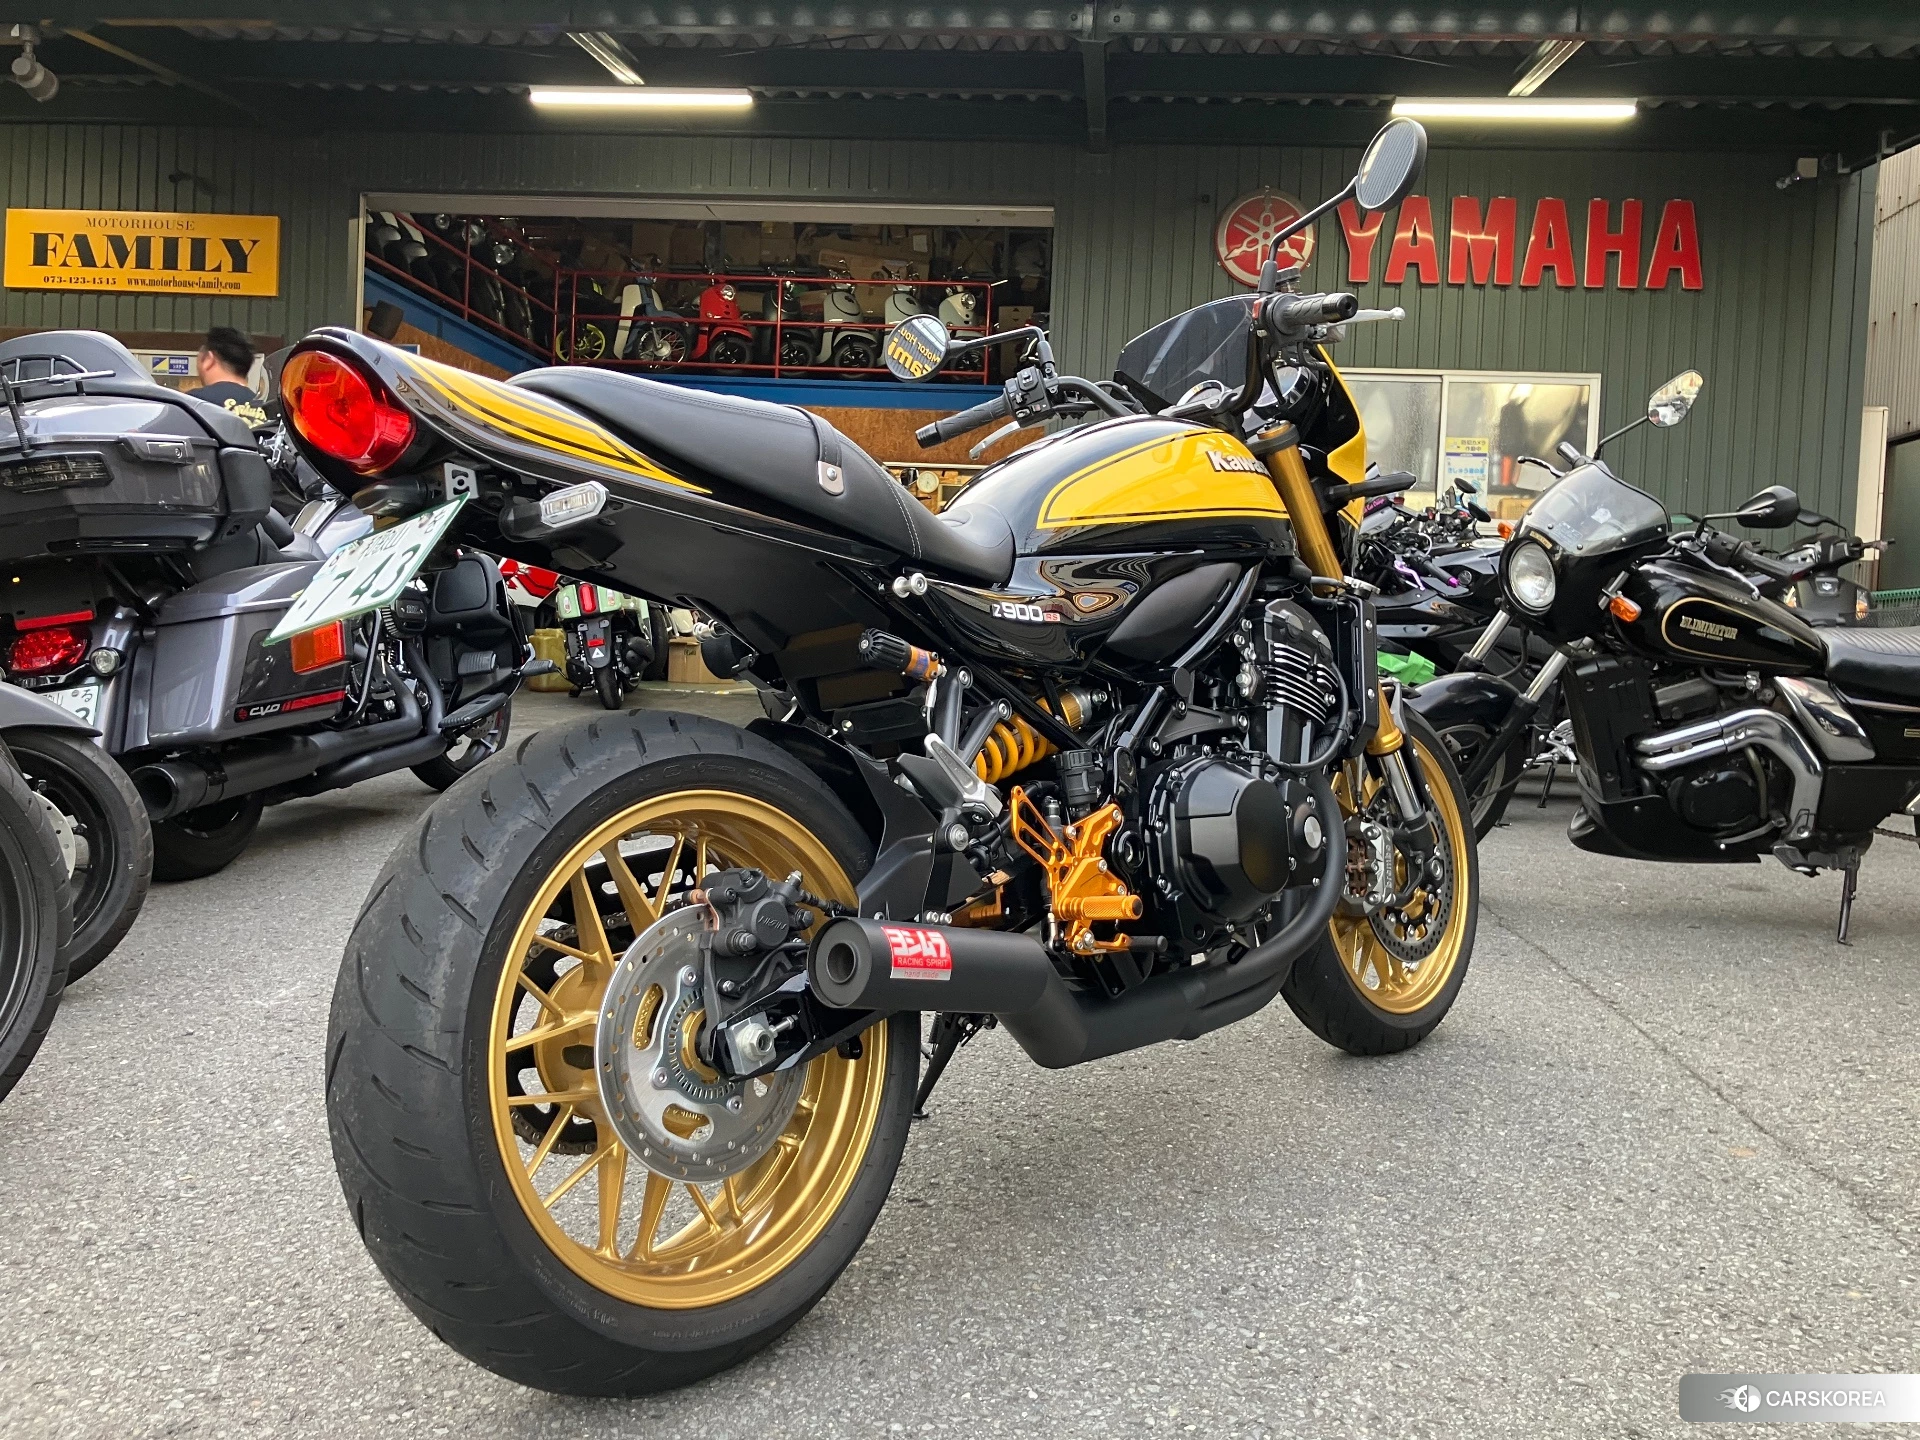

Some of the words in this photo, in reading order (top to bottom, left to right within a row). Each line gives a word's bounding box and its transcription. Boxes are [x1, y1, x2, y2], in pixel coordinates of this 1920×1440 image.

[86, 217, 195, 231] MOTORHOUSE
[28, 232, 260, 273] FAMILY
[1335, 195, 1703, 290] YAMAHA
[1680, 615, 1738, 640] ELIMINATOR
[249, 703, 281, 717] CVO
[884, 928, 947, 958] ヨシムラ
[897, 957, 925, 967] RACING
[926, 958, 949, 968] SPIRIT
